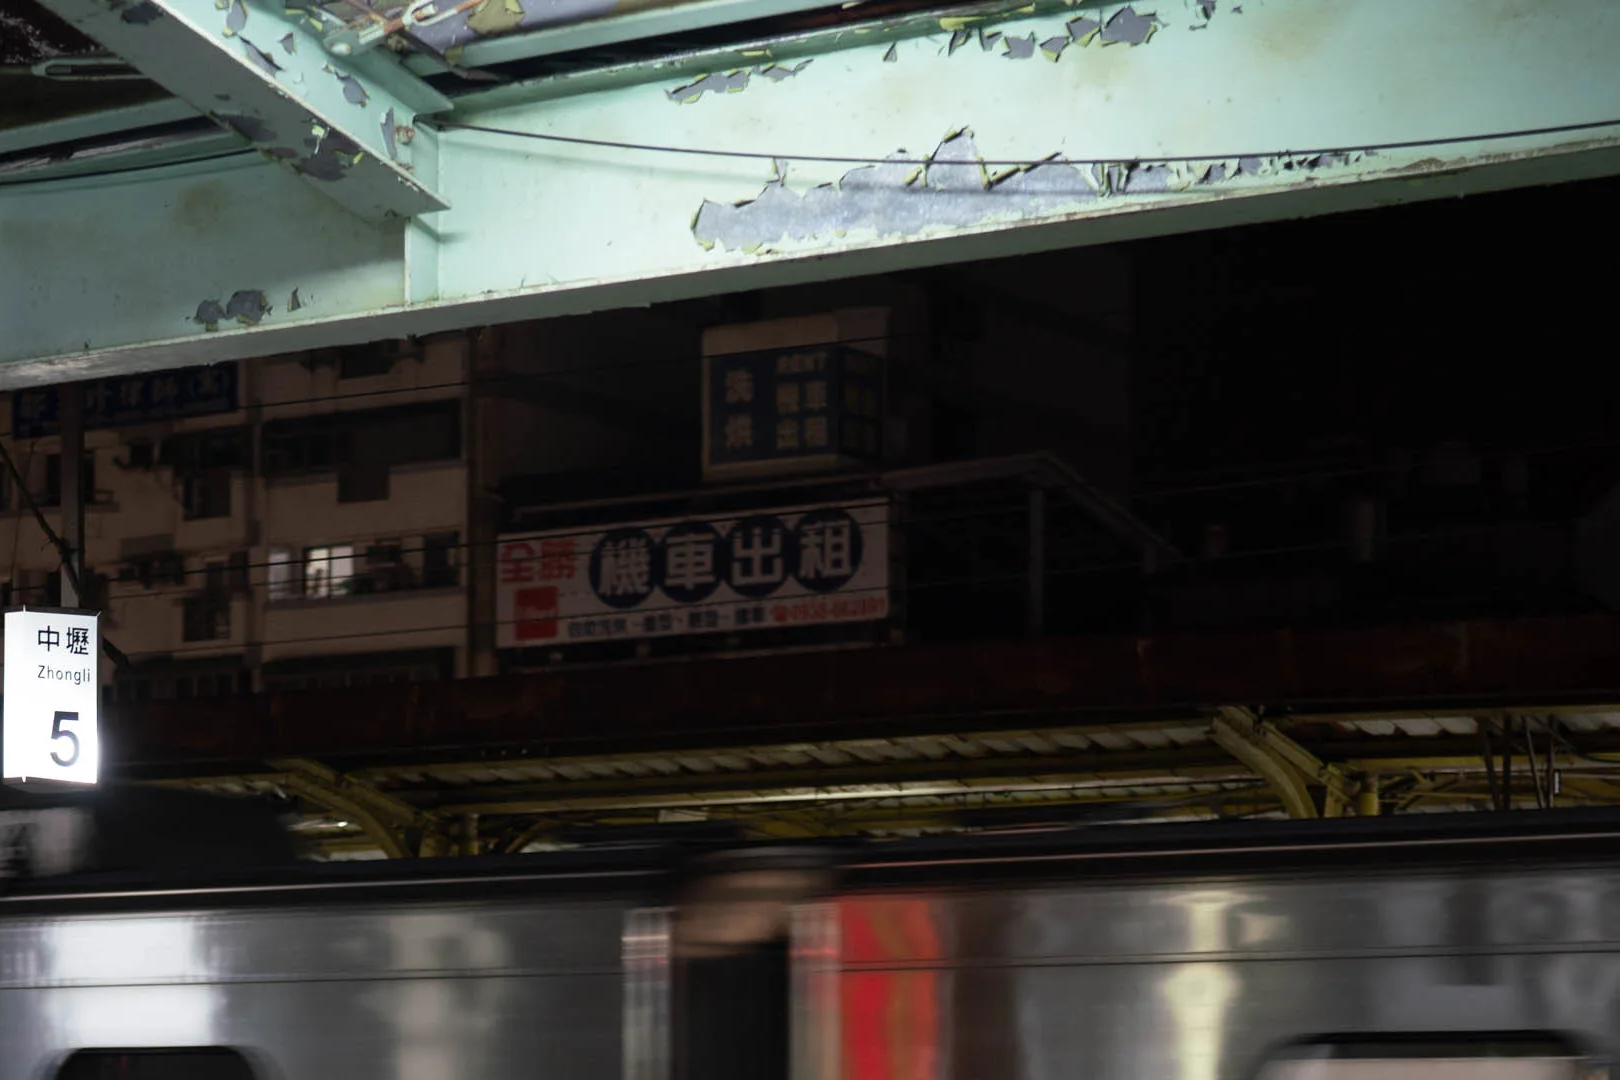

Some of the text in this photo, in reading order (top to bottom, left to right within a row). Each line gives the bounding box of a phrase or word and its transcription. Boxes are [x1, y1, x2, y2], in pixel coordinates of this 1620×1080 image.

[501, 537, 576, 584] 全勝
[596, 517, 854, 597] 機車出租
[38, 625, 89, 655] 中壢
[38, 665, 91, 685] Zhongli
[50, 711, 80, 767] 5
